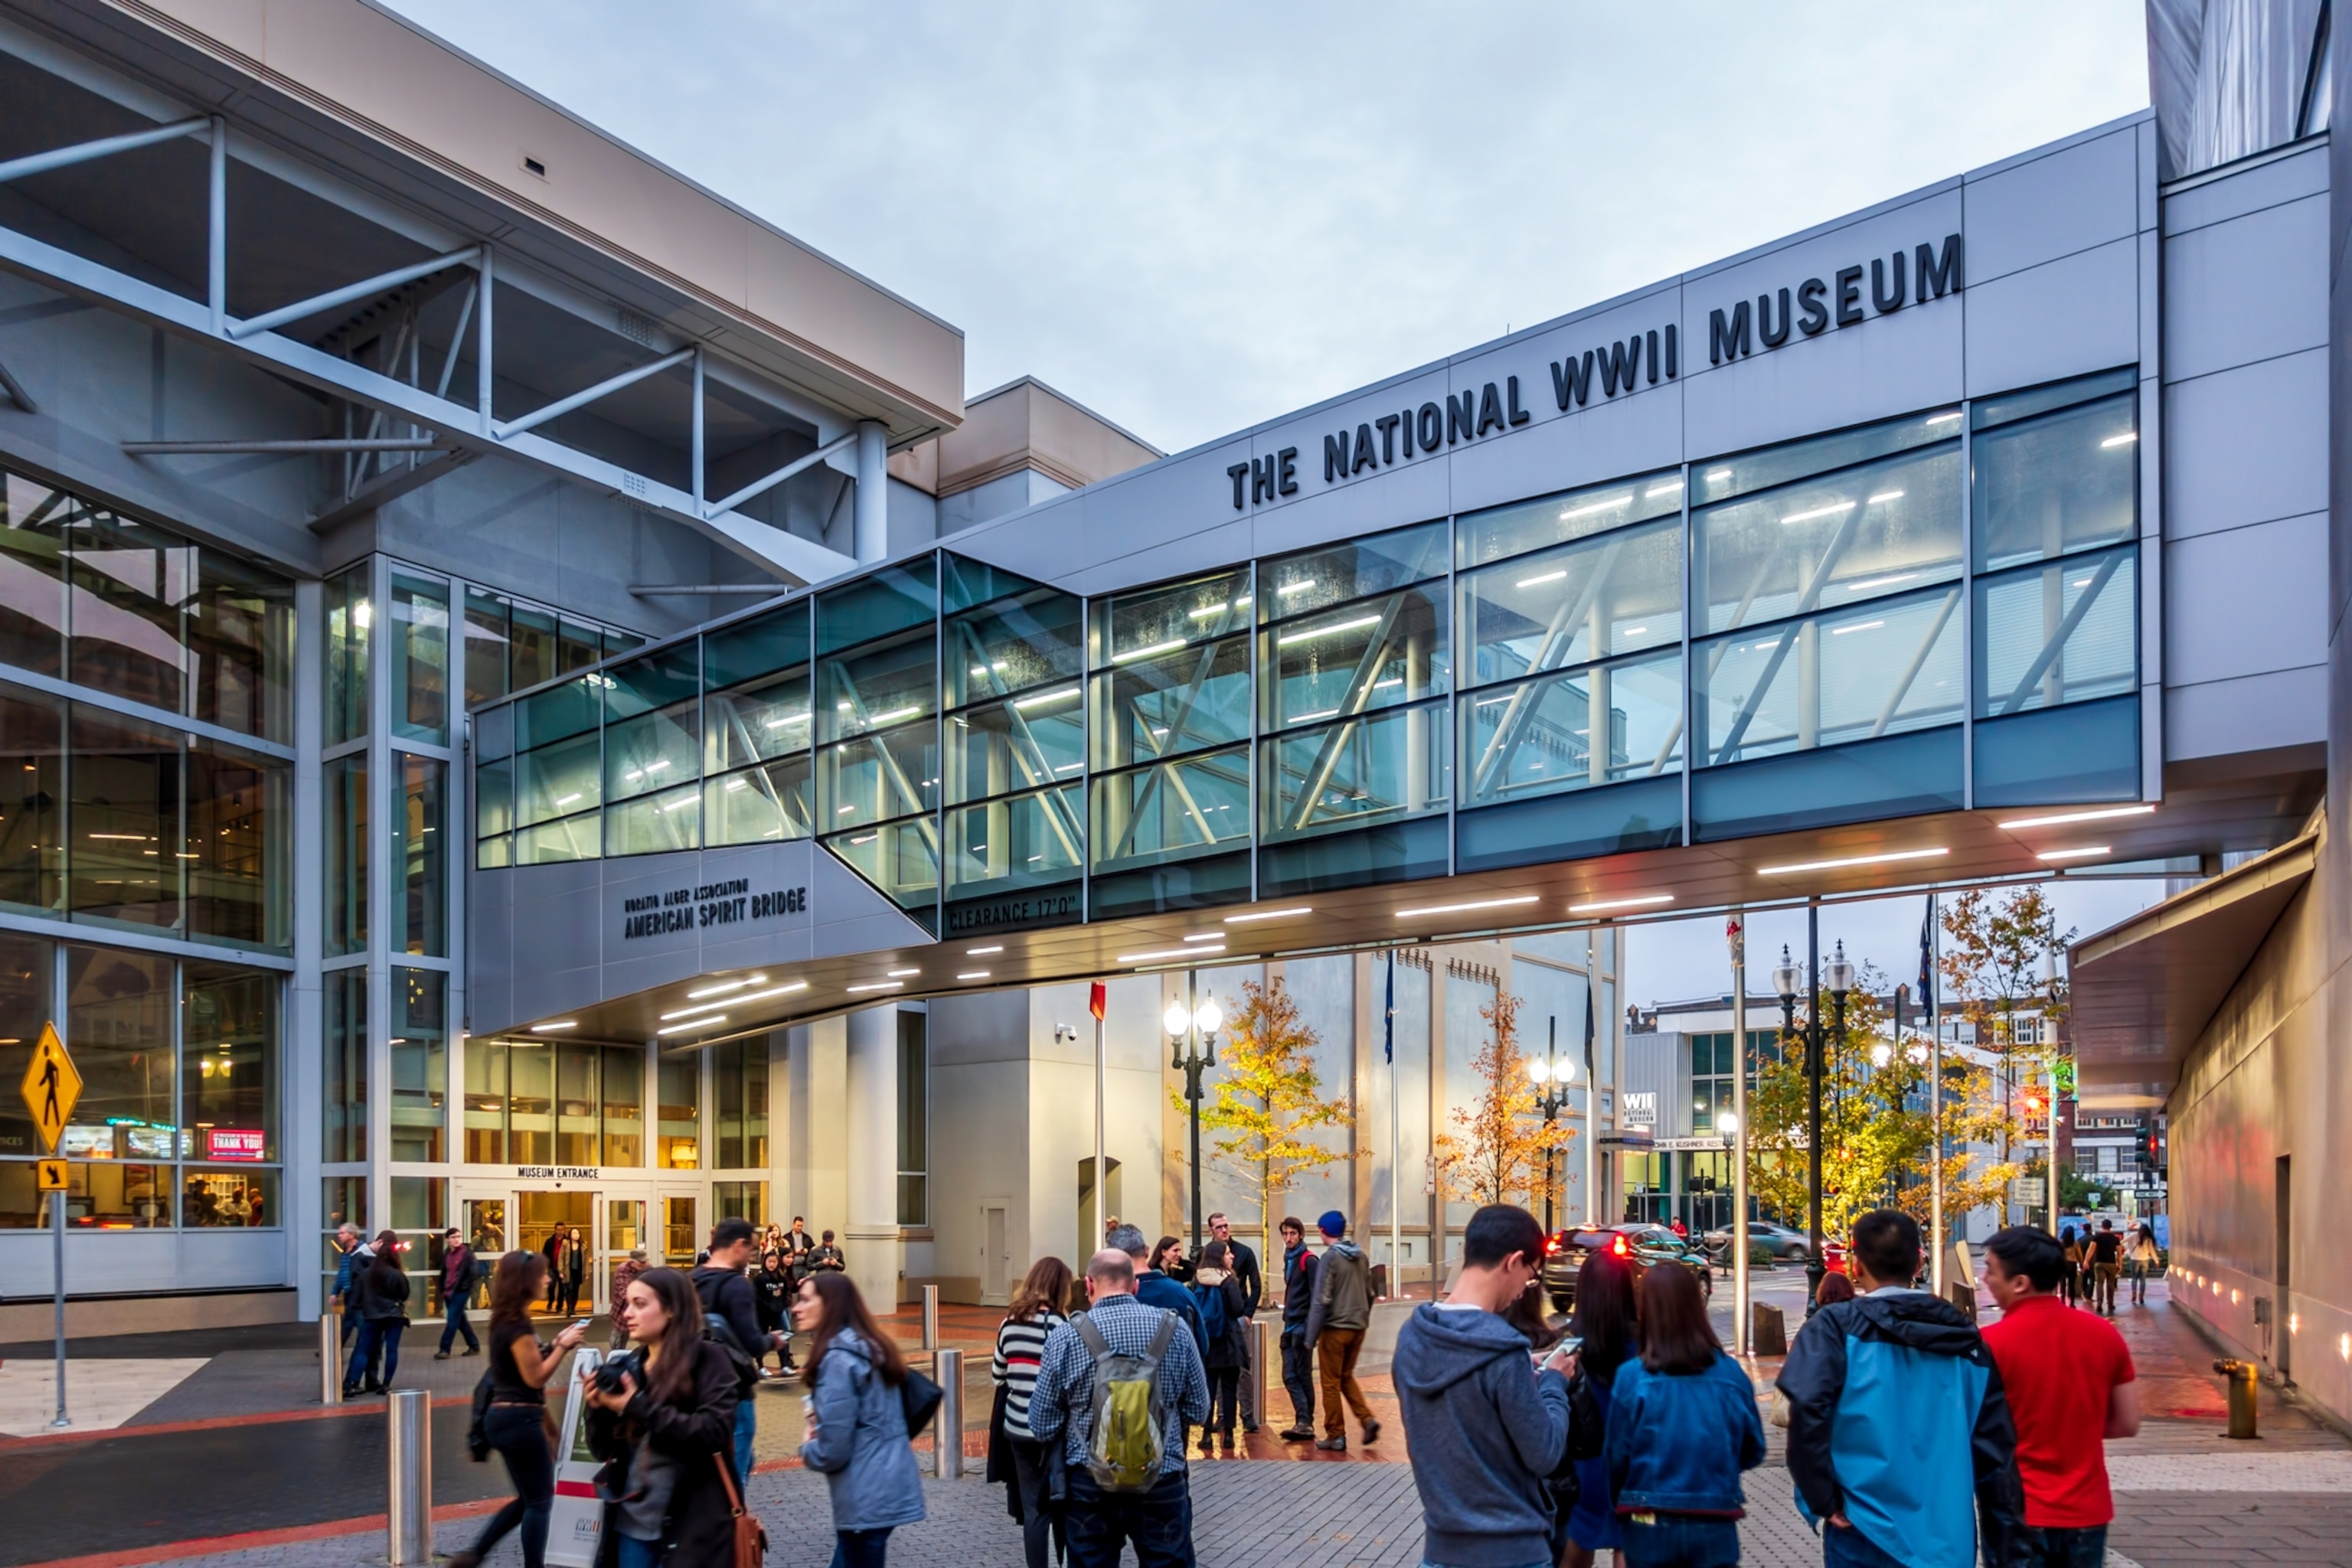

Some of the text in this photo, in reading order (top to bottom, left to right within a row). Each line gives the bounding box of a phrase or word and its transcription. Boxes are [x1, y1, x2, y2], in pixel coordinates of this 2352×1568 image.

[1227, 233, 1962, 510] THE NATIONAL WWII MUSEUM
[625, 878, 749, 913] HORATIO ALGER ASSOCIATION
[625, 887, 806, 939] AMERICAN SPIRIT BRIDGE
[949, 903, 1029, 931] CLEARANCE
[213, 1137, 263, 1150] THANK YOU!
[1676, 1140, 1704, 1148] KUSHNER
[518, 1167, 599, 1179] MUSEUM ENTRANCE
